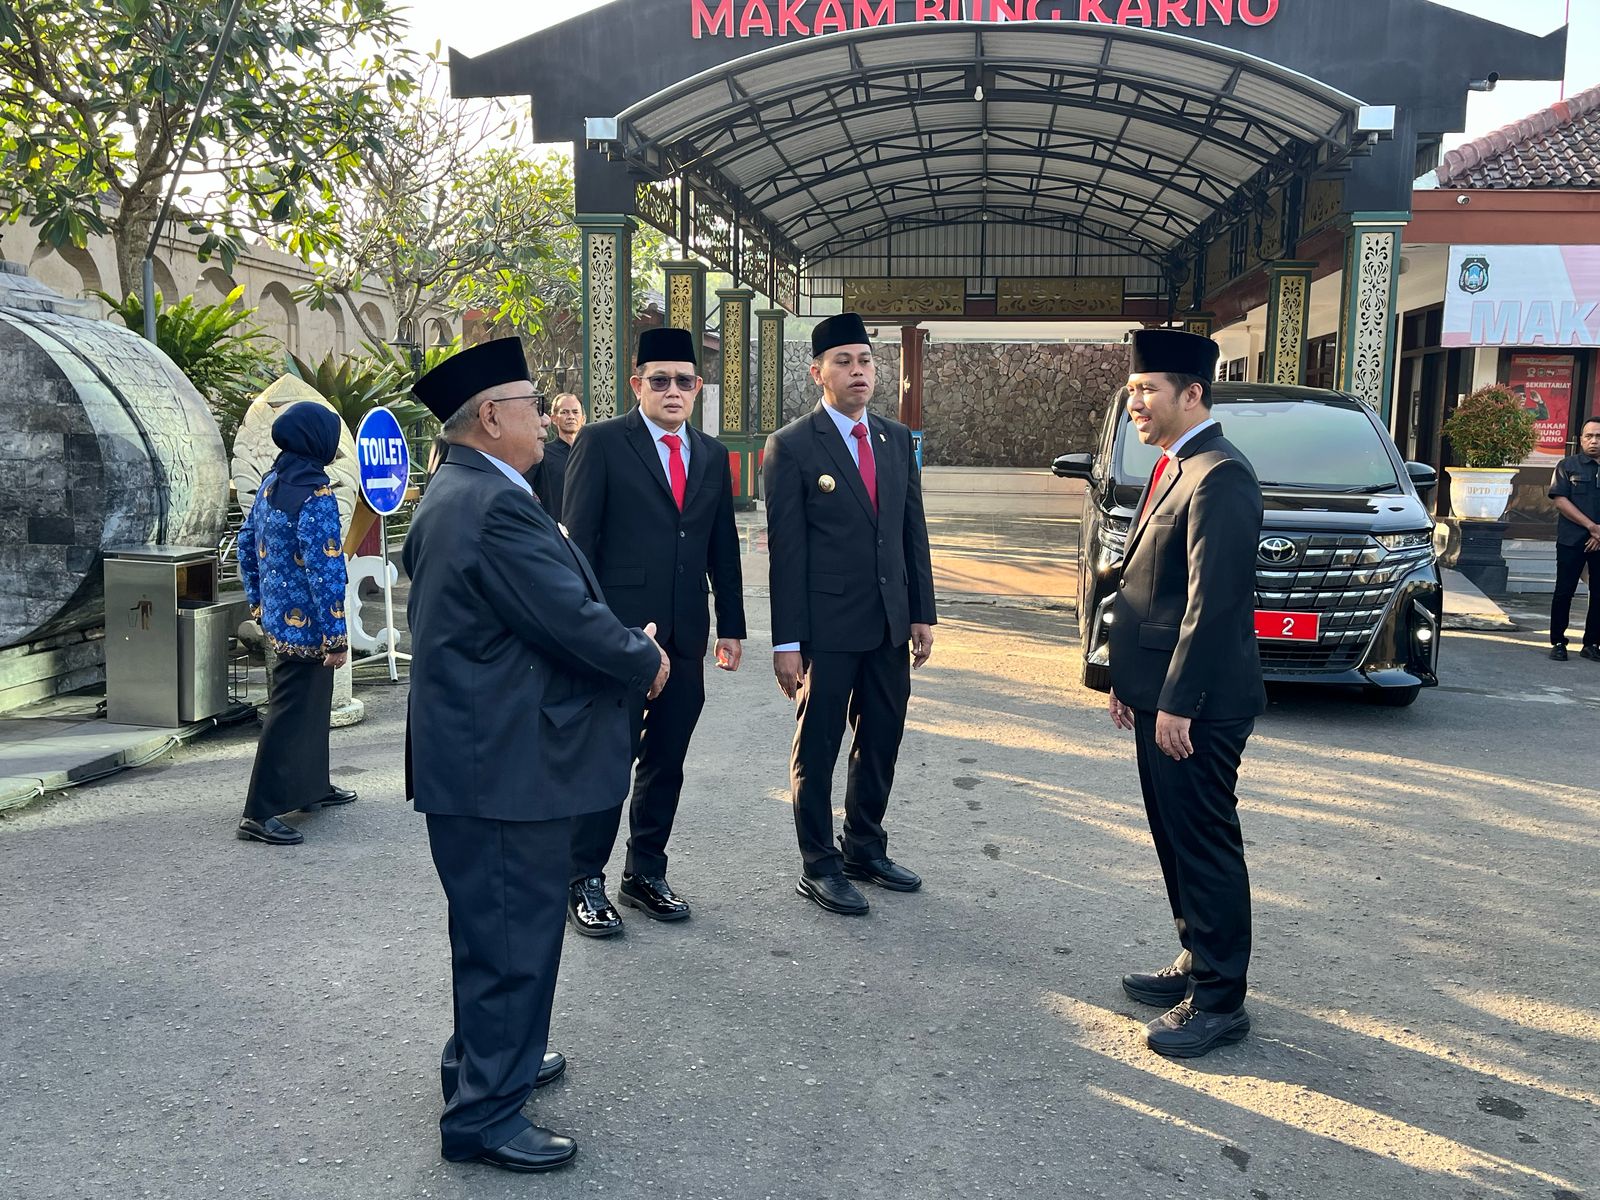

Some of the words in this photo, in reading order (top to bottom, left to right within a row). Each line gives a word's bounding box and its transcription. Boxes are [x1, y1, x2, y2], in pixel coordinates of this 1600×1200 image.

[691, 0, 896, 39] MAKAM
[1079, 0, 1279, 28] KARNO
[1470, 300, 1600, 345] MAK
[360, 437, 402, 466] TOILET
[1282, 617, 1295, 636] 2
